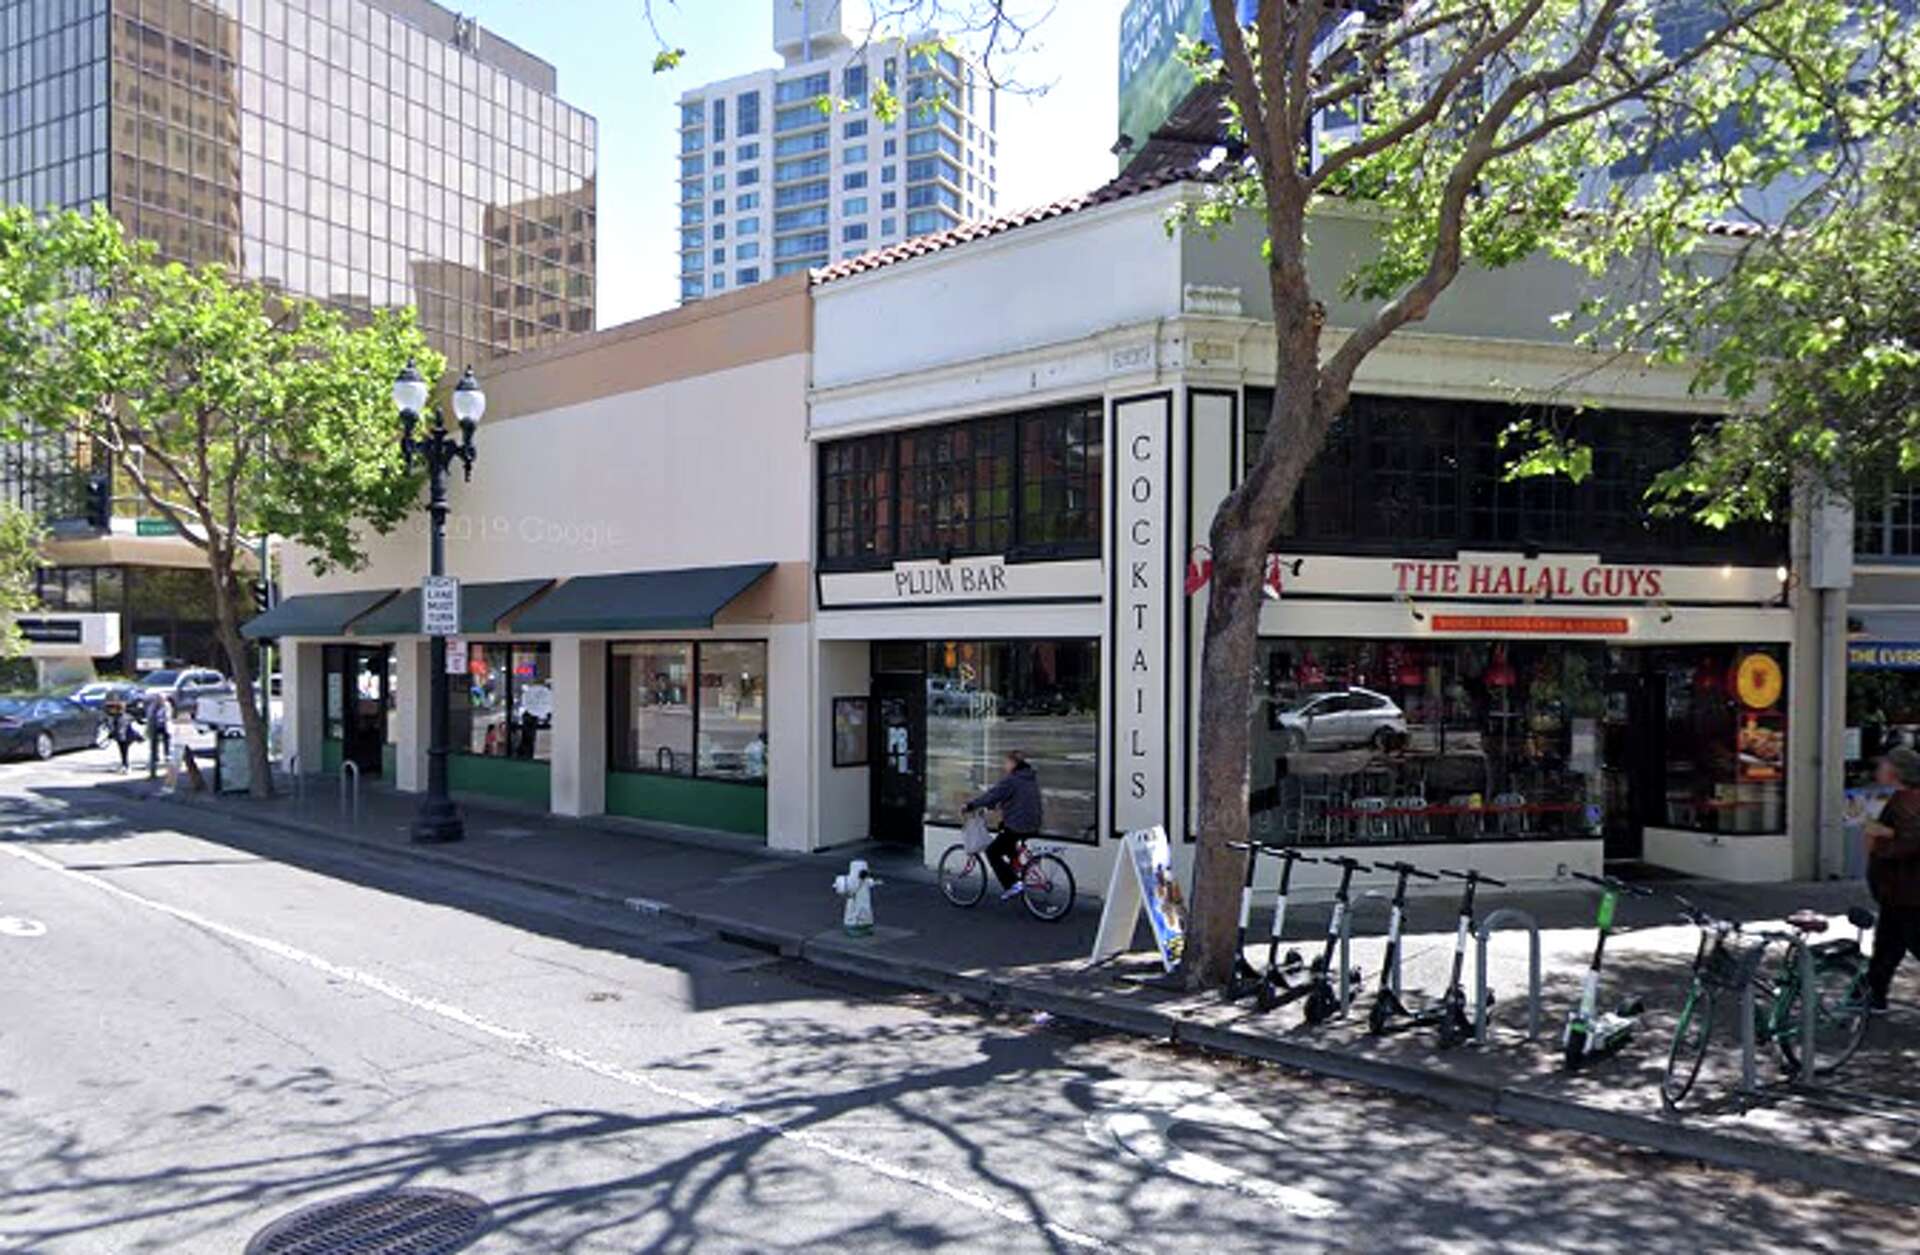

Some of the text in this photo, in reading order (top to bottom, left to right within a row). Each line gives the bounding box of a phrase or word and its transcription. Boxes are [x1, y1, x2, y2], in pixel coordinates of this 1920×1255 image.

[895, 564, 1007, 596] PLUM BAR
[1392, 562, 1663, 598] THE HALAL GUYS
[1131, 434, 1151, 799] COCKTAILS
